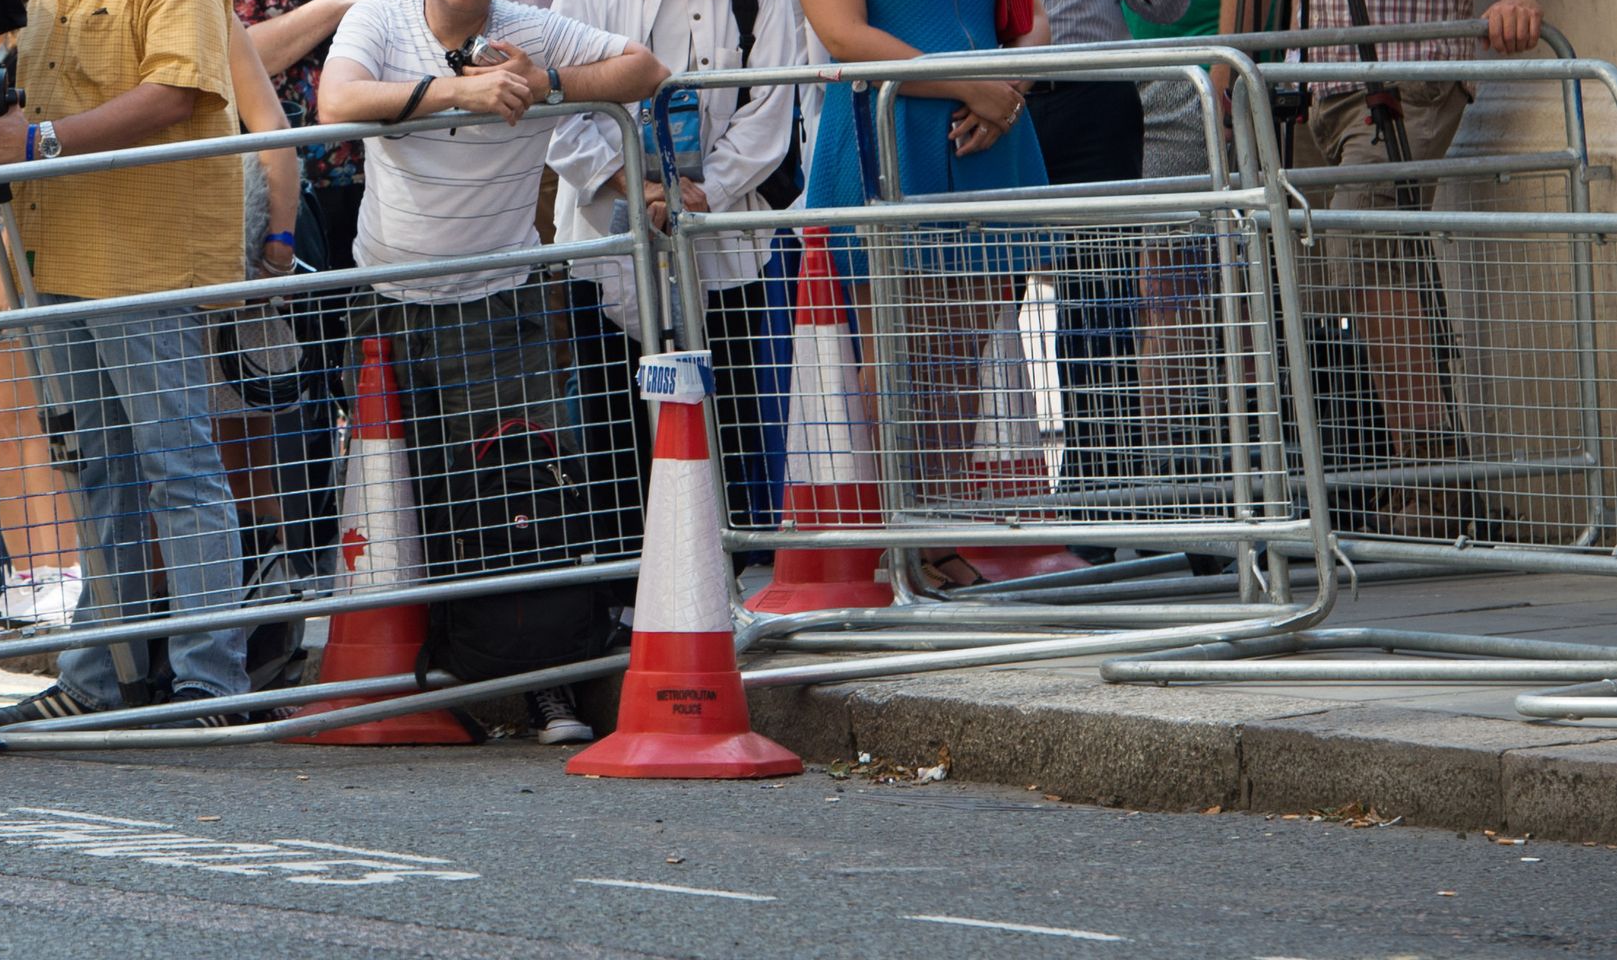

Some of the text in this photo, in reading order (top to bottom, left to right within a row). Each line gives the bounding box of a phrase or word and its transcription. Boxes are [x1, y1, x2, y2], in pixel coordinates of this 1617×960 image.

[646, 365, 677, 395] CROSS
[656, 689, 717, 701] METROPOLITAN
[672, 703, 702, 715] POLICE
